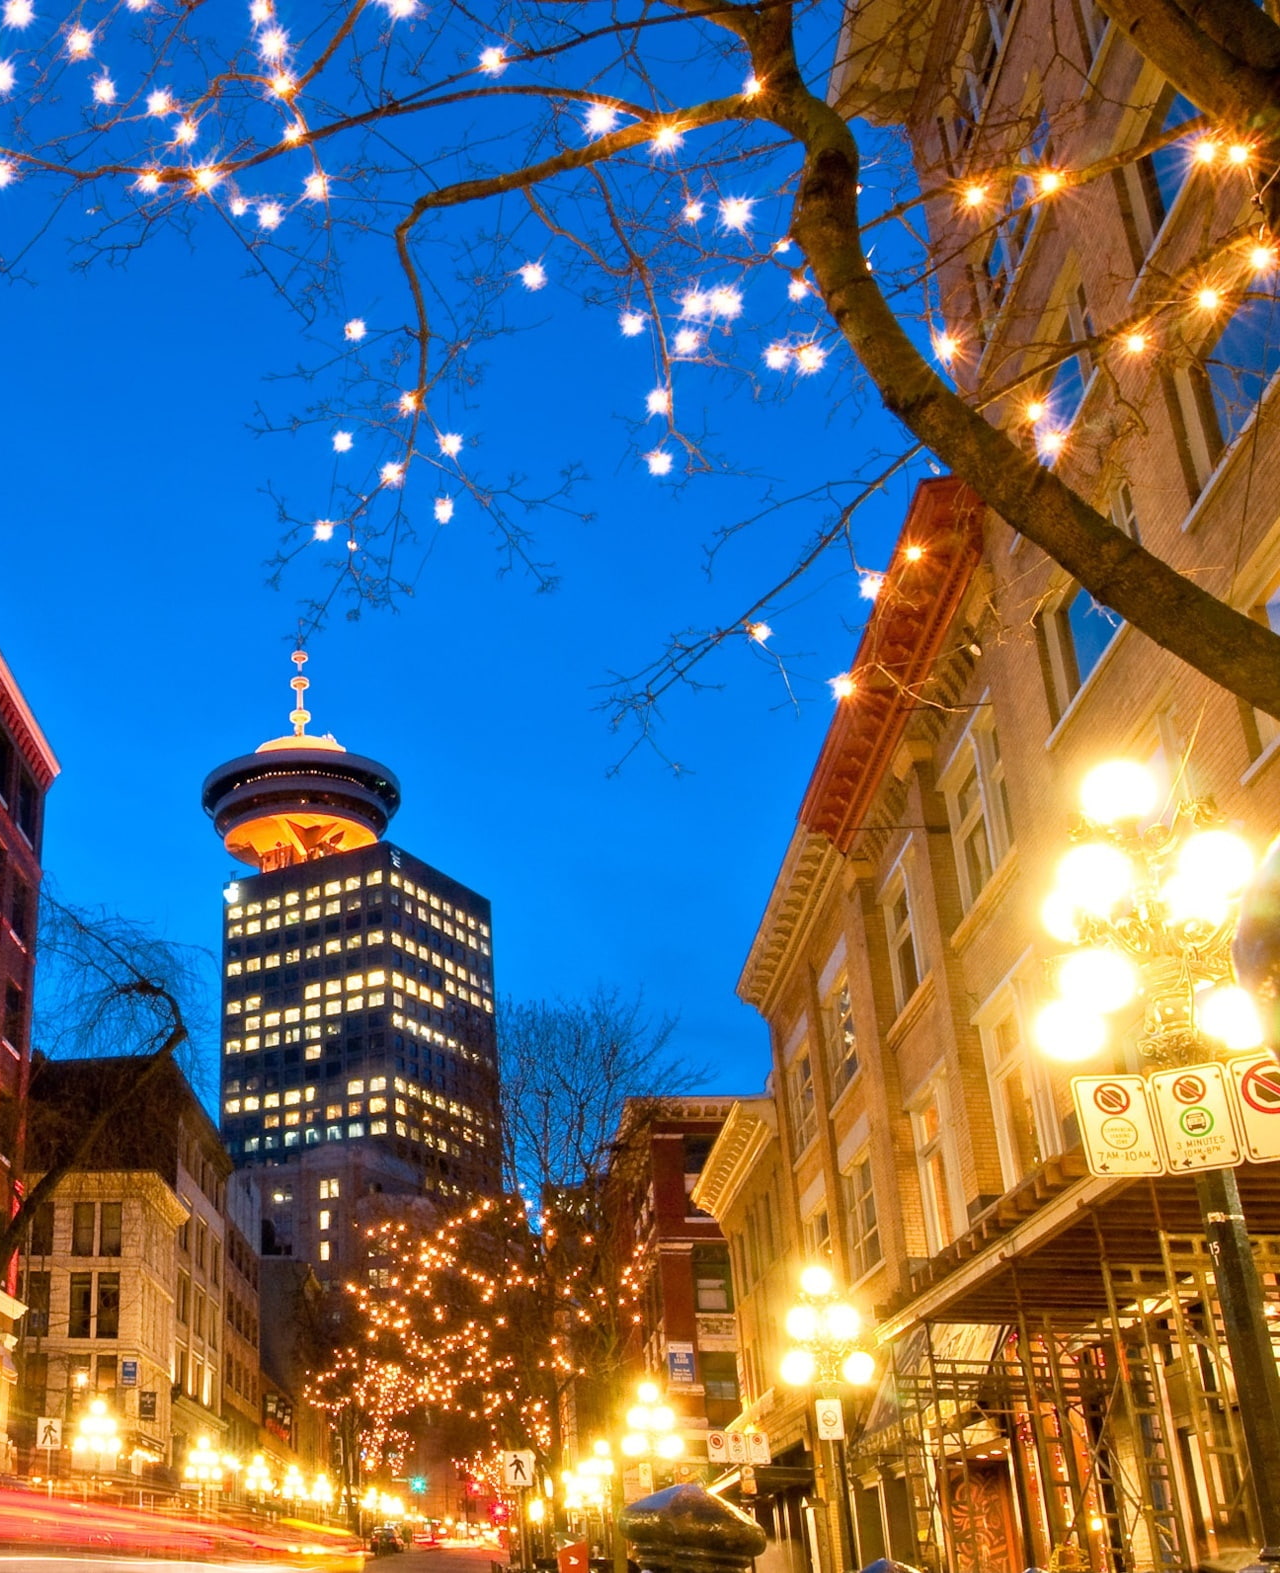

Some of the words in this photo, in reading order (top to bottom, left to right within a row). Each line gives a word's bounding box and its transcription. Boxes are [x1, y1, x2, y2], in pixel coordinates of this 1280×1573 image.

[1176, 1142, 1183, 1150] 3
[1186, 1135, 1226, 1148] MINUTES
[1209, 1241, 1220, 1255] 15
